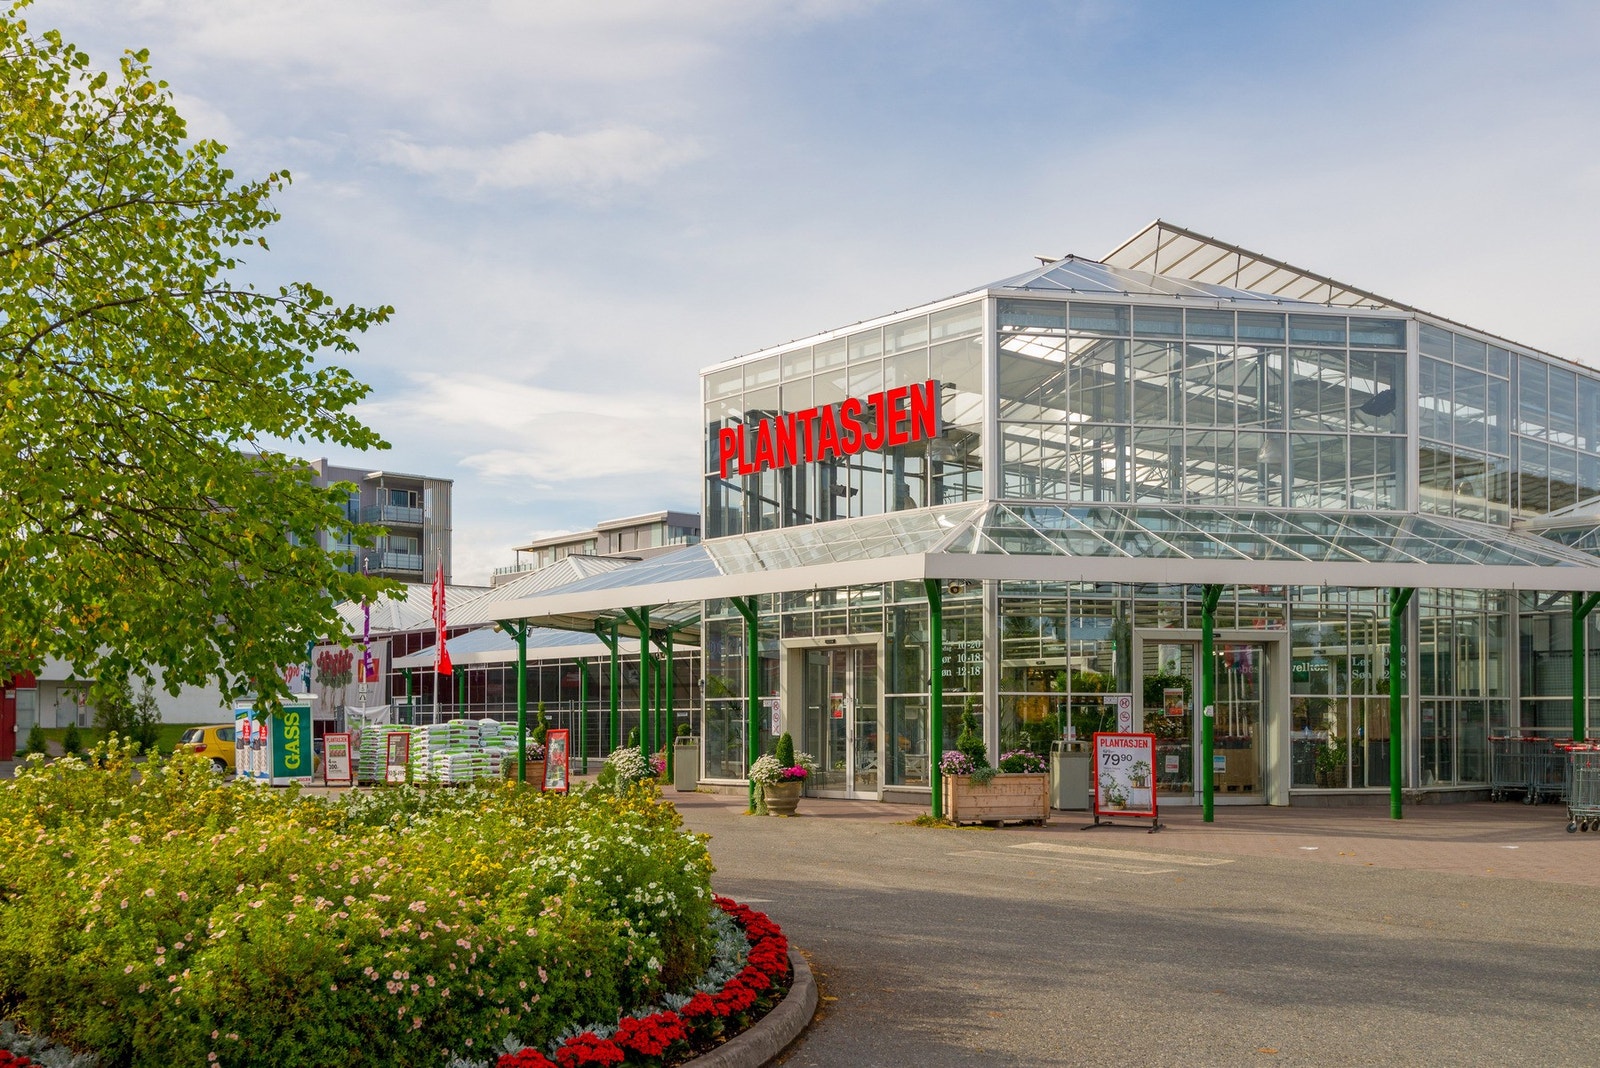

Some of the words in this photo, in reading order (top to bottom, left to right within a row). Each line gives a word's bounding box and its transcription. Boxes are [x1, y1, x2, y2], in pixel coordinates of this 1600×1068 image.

[719, 379, 938, 479] PLANTASJEN
[284, 712, 301, 770] GASS
[1100, 738, 1149, 748] PLANTASJEN
